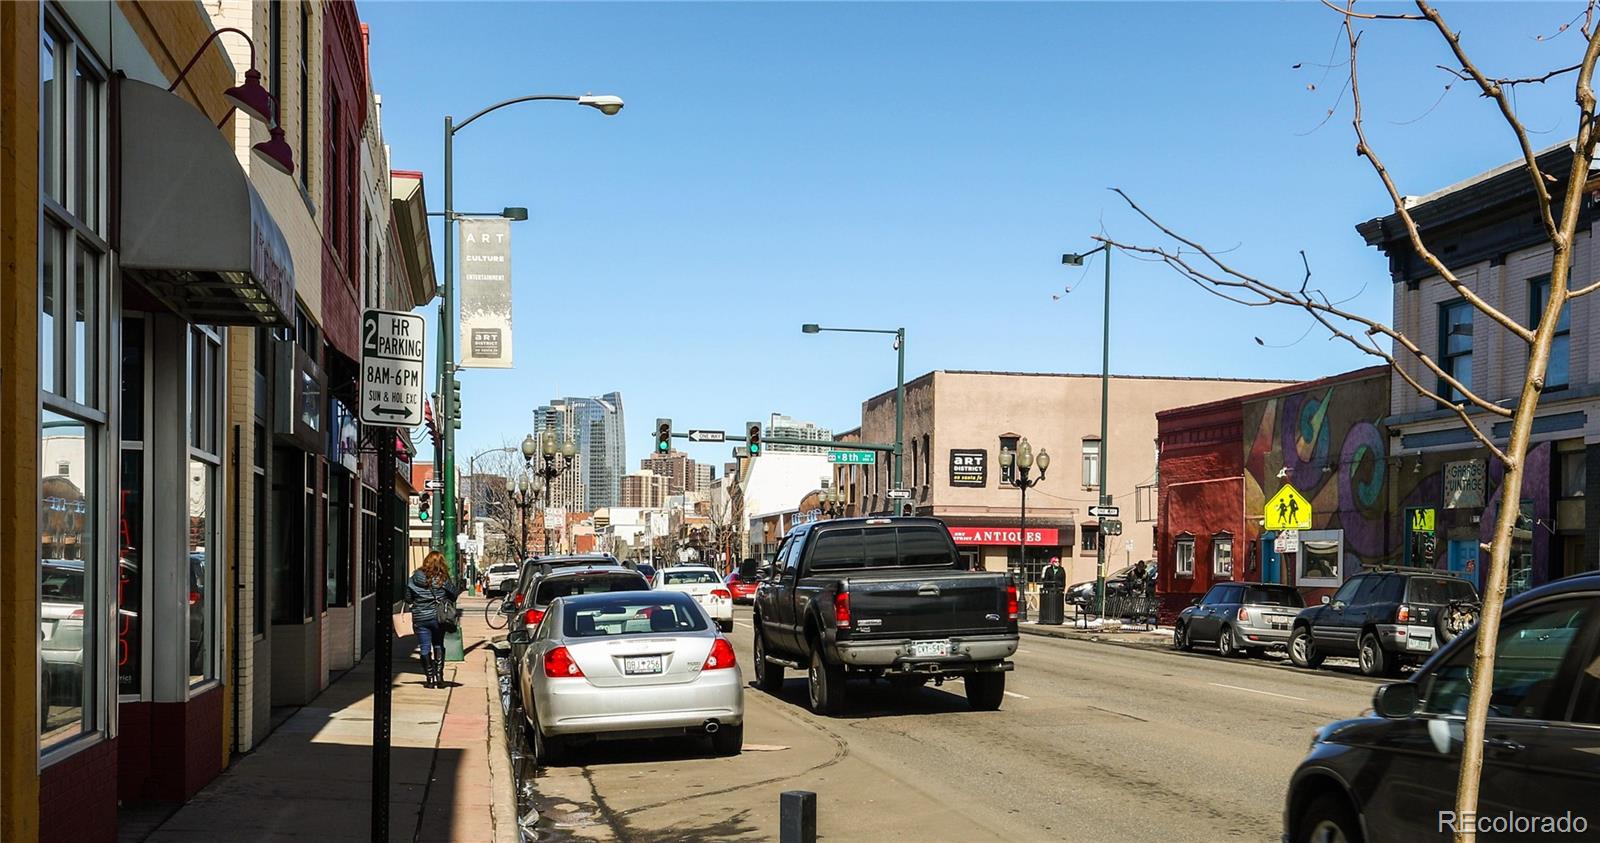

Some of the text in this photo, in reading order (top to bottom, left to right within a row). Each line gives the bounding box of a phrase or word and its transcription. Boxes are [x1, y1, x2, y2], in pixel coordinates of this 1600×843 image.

[466, 233, 504, 243] ART
[364, 318, 410, 350] 2 HR
[379, 336, 421, 357] PARKING
[369, 390, 417, 404] SUN & HOL EXC
[842, 453, 859, 462] 8th
[973, 531, 1042, 543] ANTIQUES
